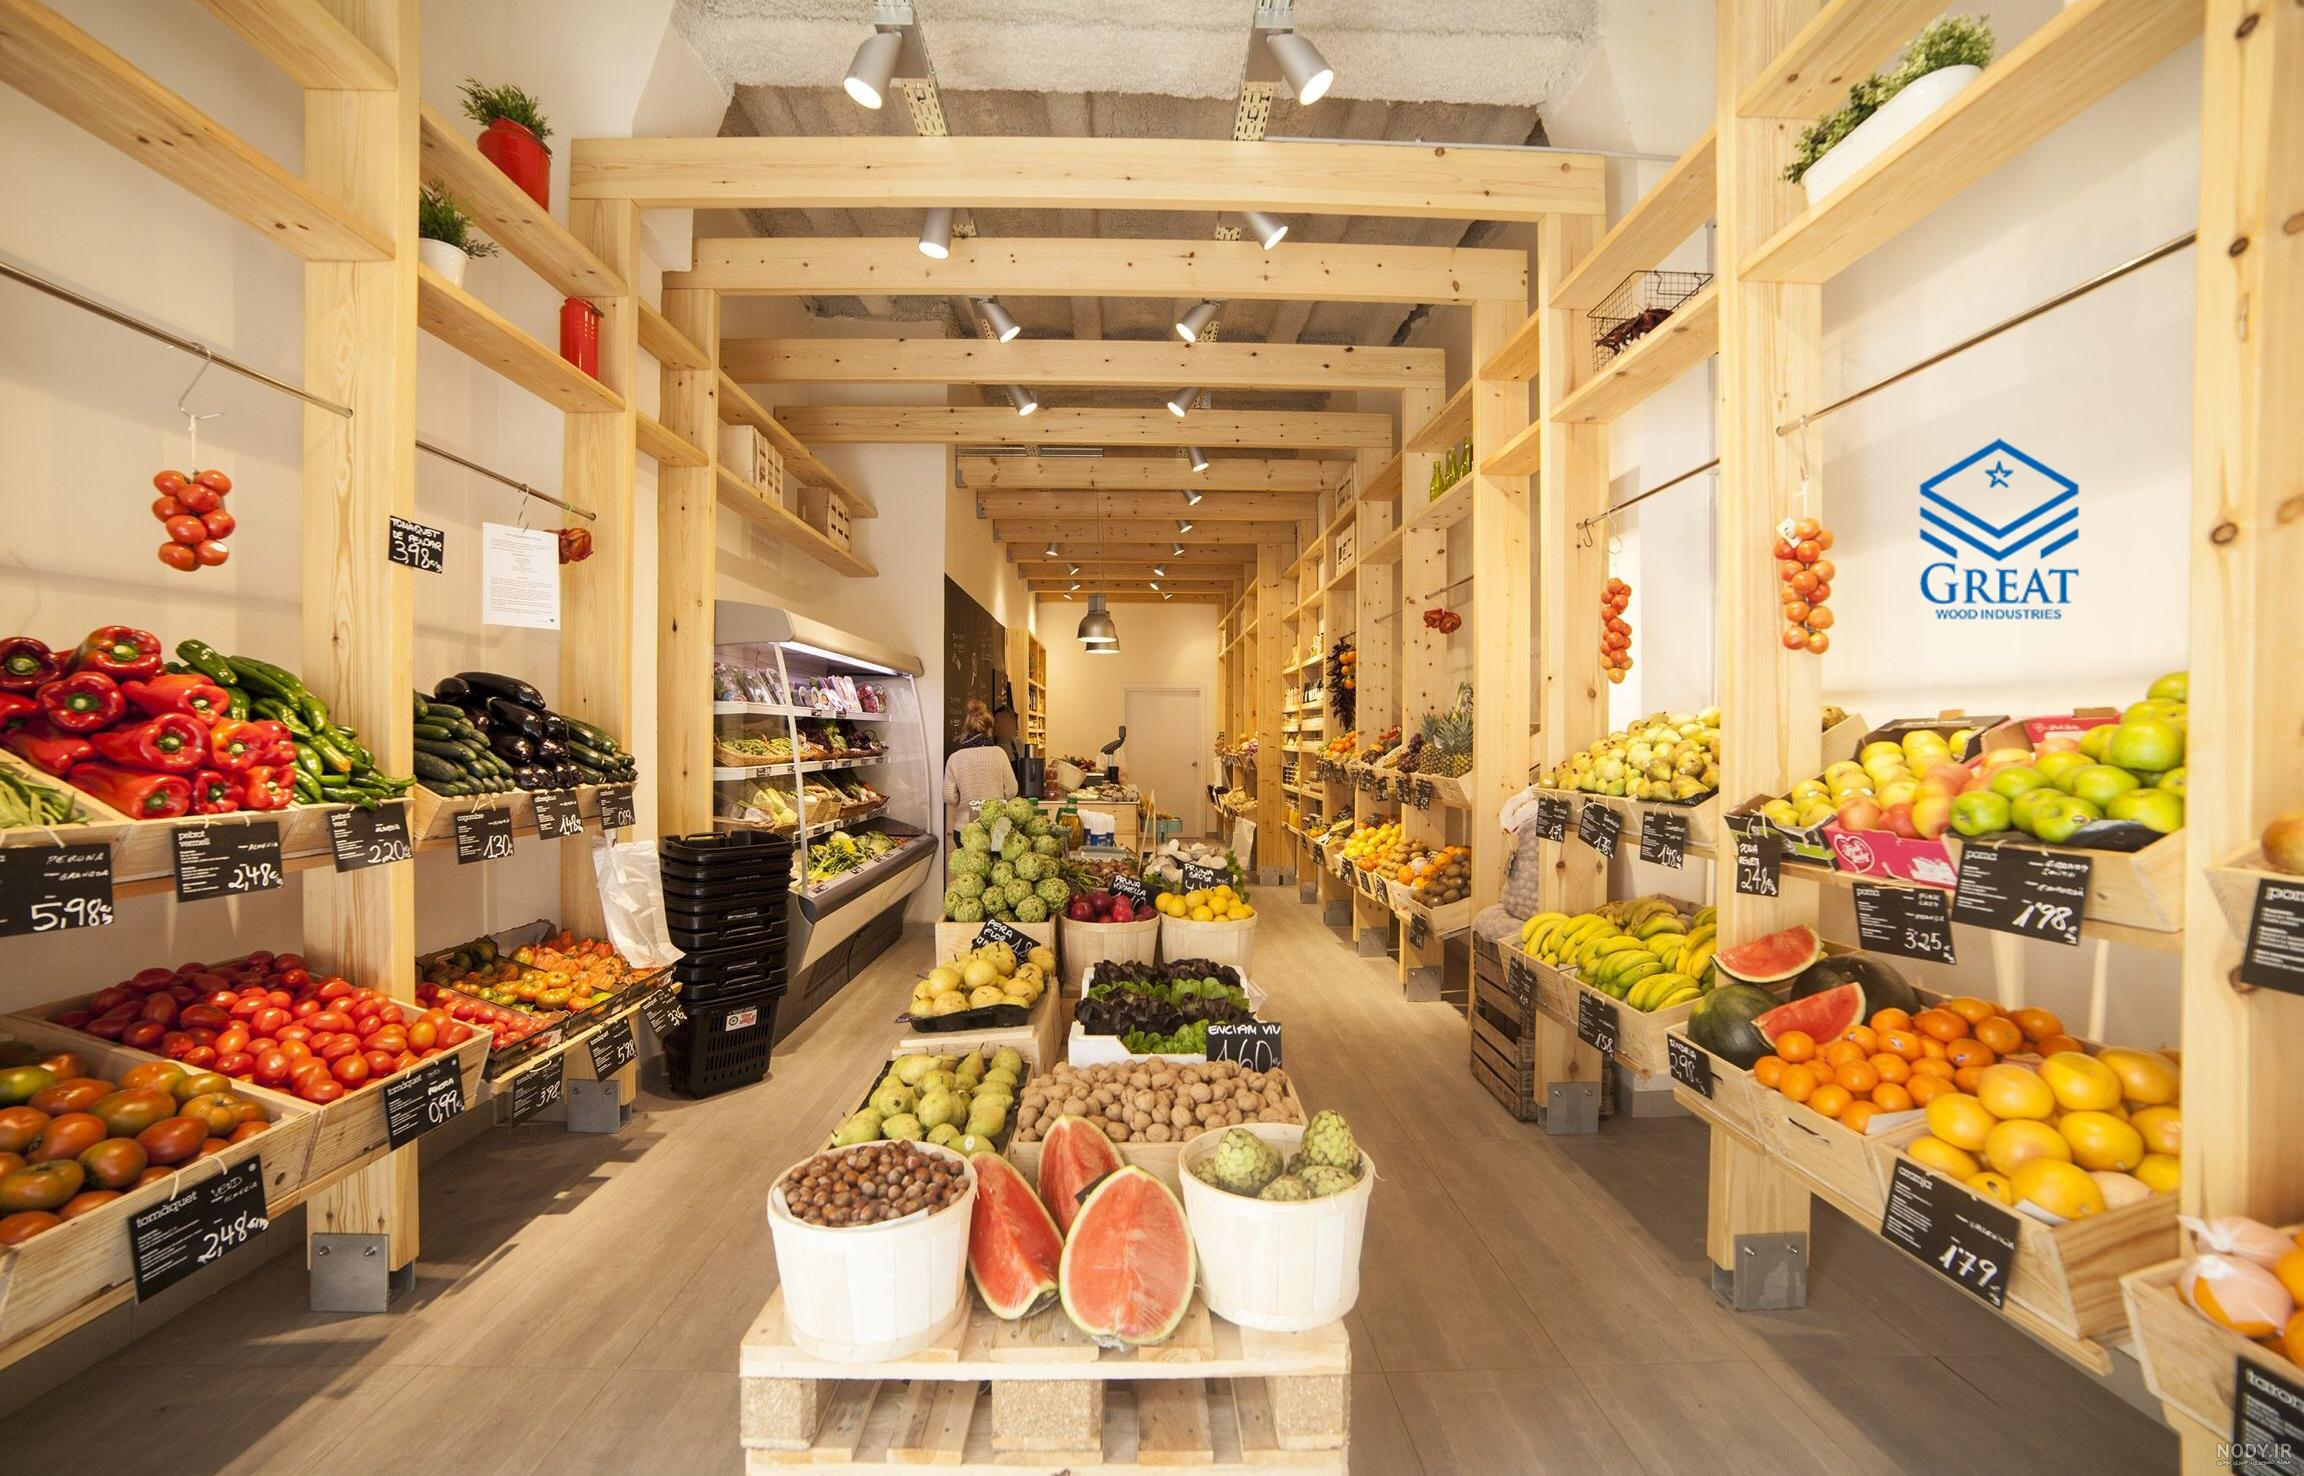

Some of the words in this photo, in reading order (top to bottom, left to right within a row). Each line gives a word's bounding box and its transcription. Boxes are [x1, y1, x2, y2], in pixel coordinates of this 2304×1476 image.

[392, 530, 403, 540] DE
[46, 852, 104, 865] PERONA
[1965, 850, 1997, 861] poma
[1856, 888, 1880, 897] poma
[987, 919, 1013, 938] PERA
[1208, 1024, 1257, 1035] ENCIAM
[136, 1191, 198, 1228] tomàquet
